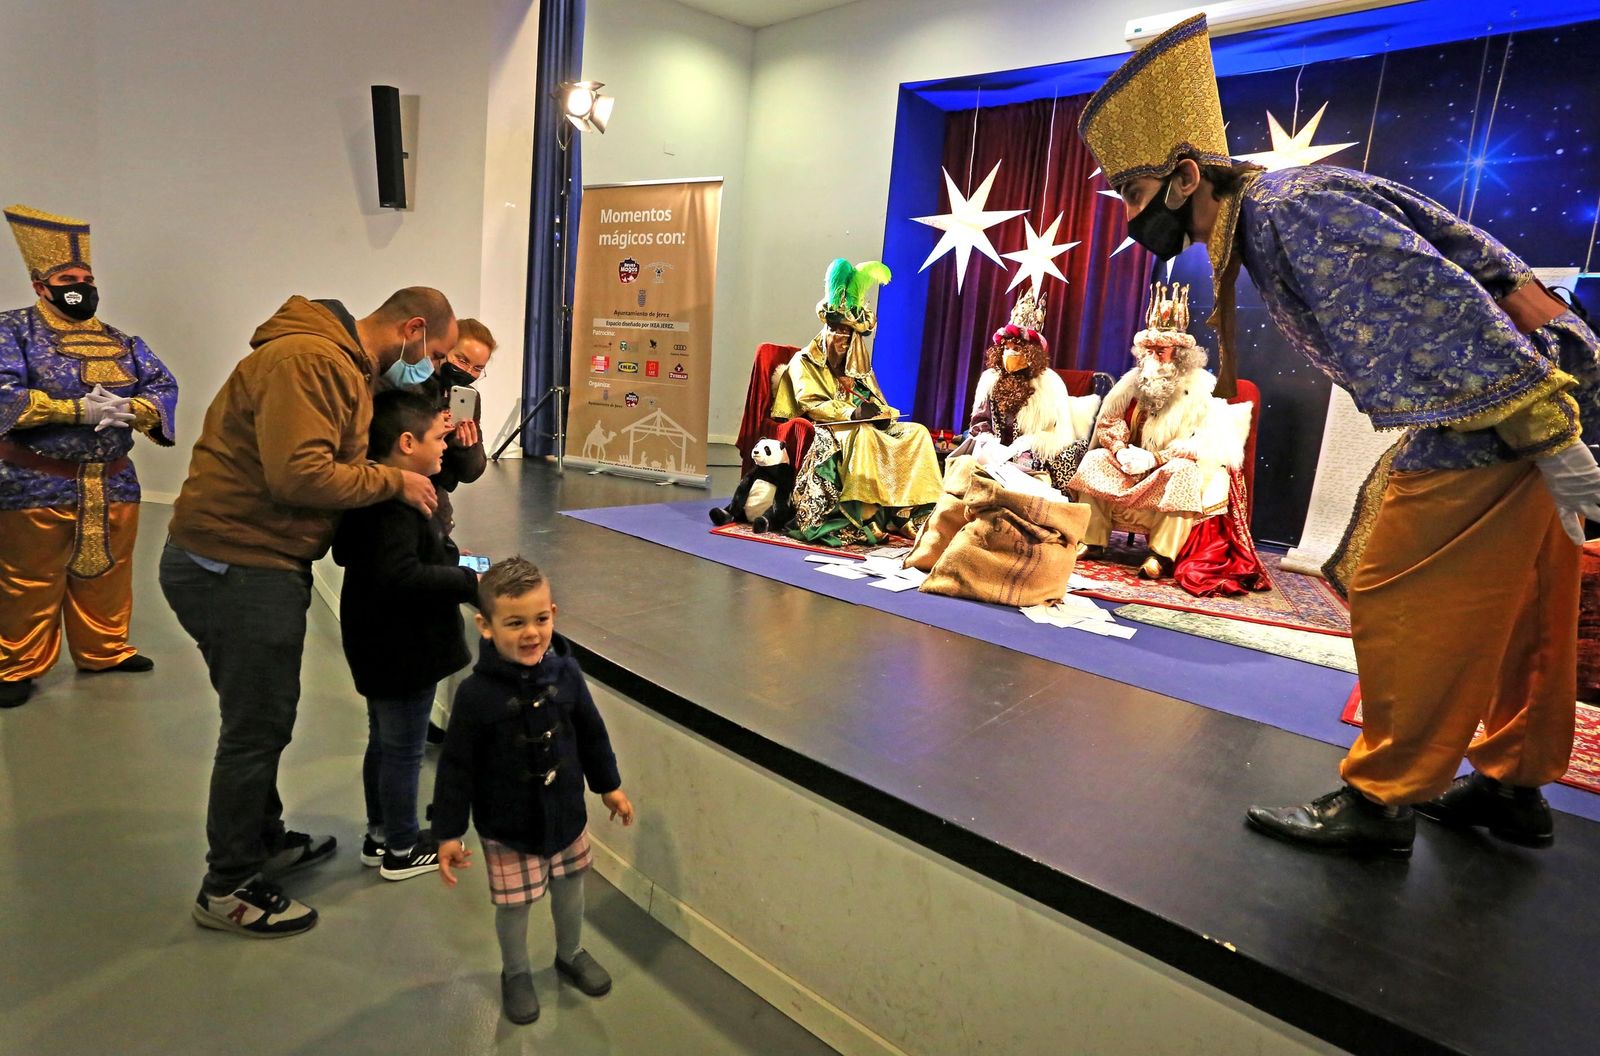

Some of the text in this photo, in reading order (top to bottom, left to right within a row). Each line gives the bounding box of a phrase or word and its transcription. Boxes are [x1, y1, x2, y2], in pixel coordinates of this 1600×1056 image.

[600, 208, 672, 223] Momentos
[599, 230, 686, 249] mágicos con:
[613, 310, 648, 318] Ayuntamiento
